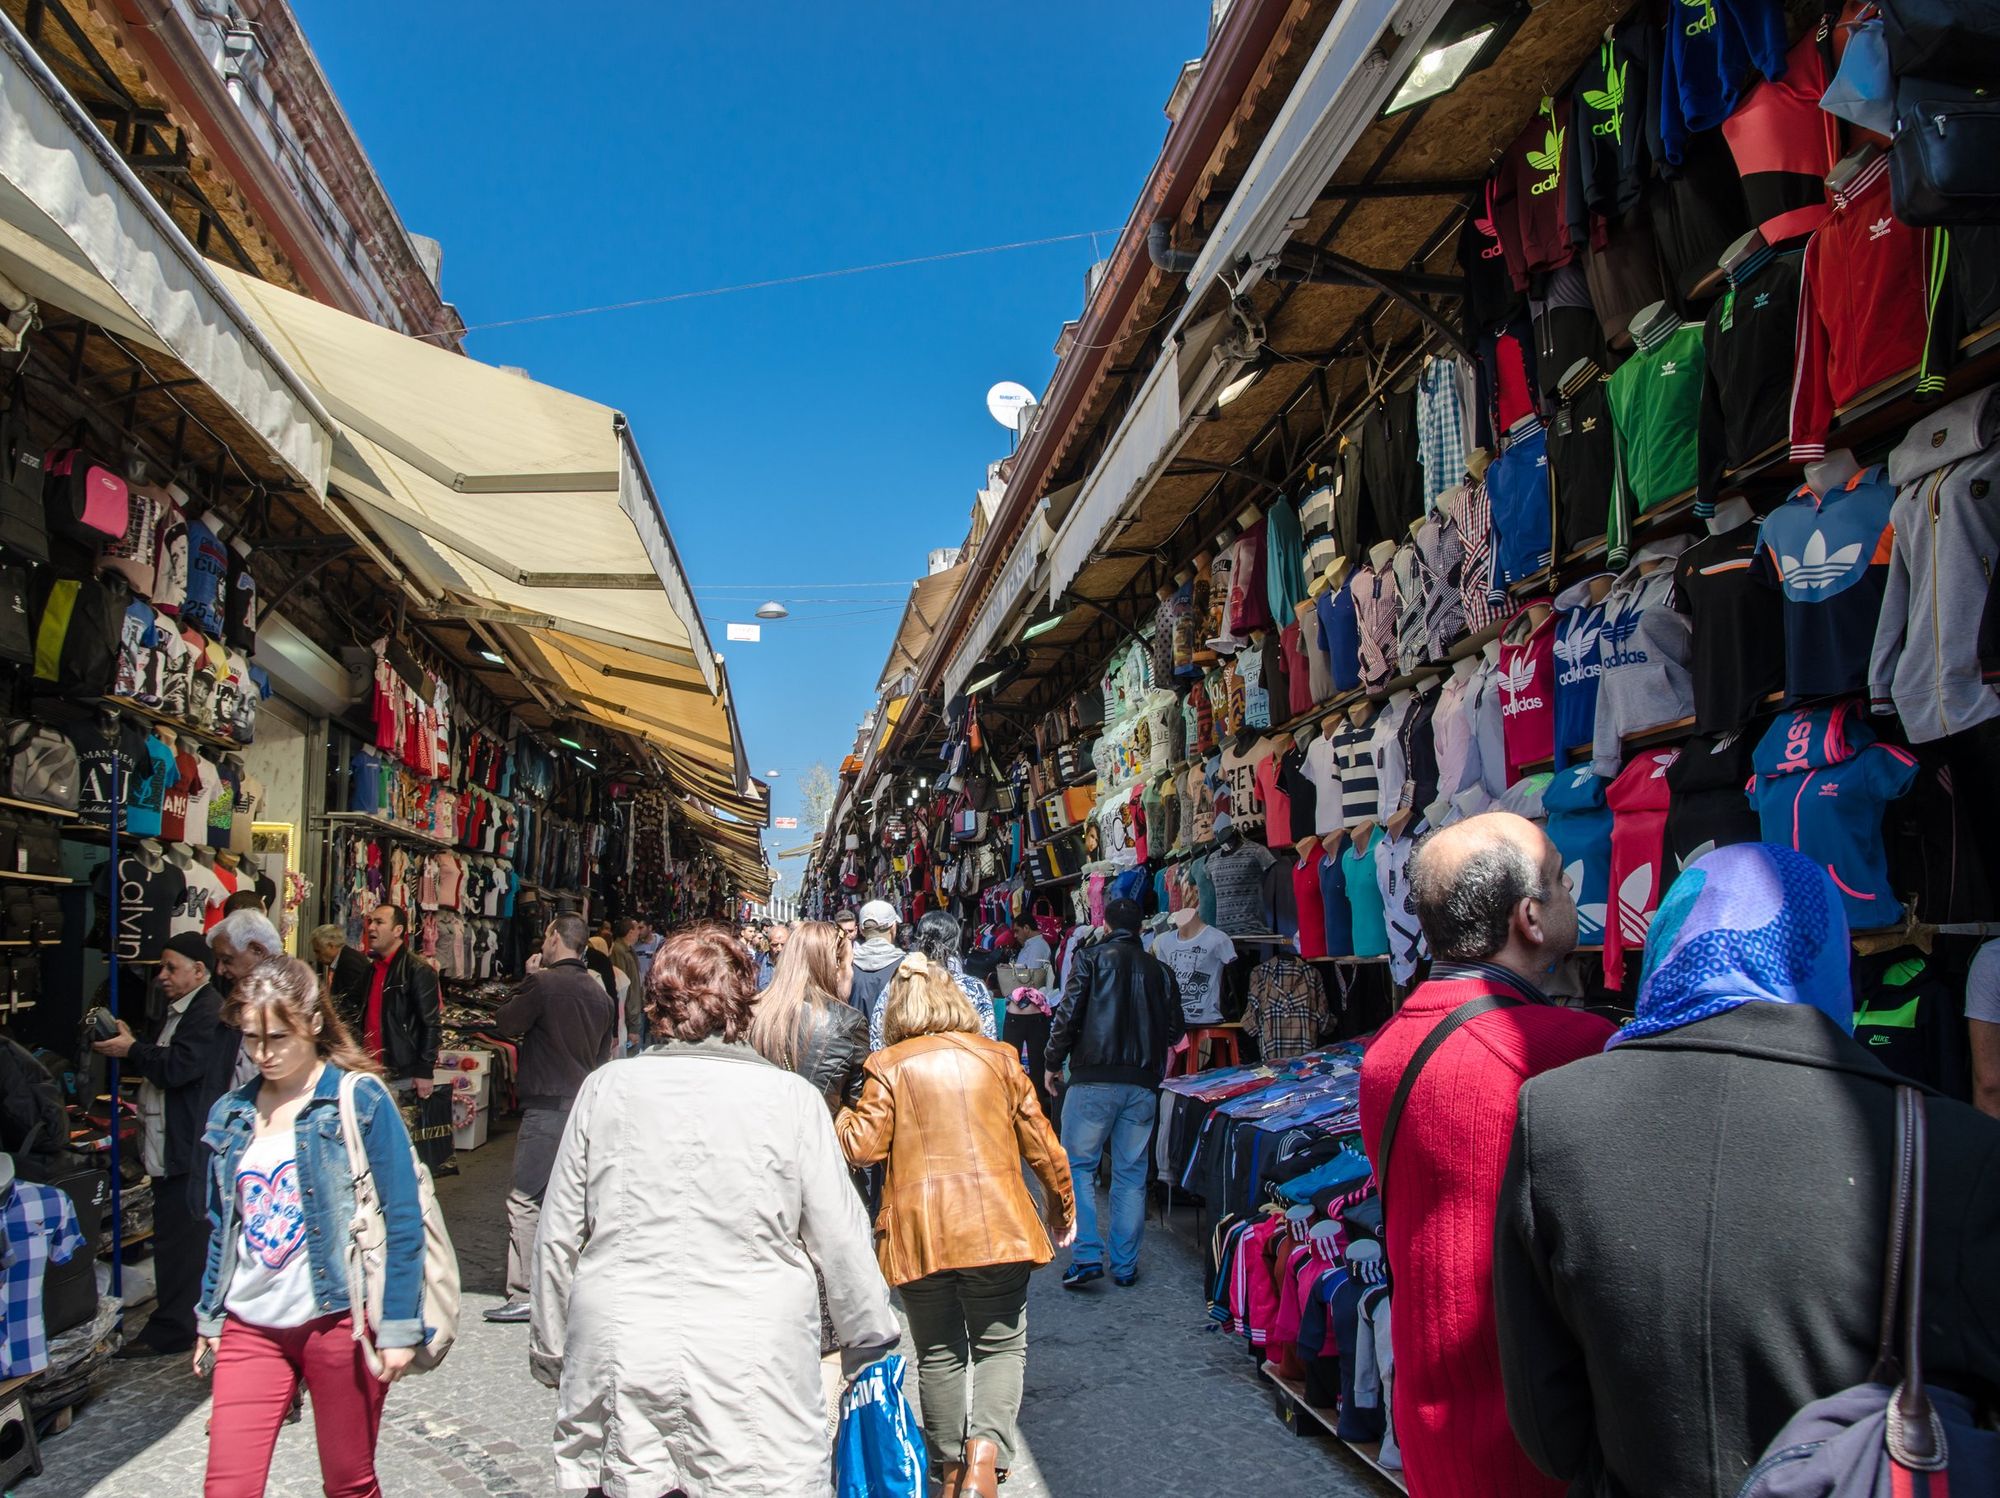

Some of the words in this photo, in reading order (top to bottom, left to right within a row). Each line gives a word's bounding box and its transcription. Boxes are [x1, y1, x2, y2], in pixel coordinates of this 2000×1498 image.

[1601, 649, 1648, 670] adidas
[1558, 662, 1601, 686] adidas
[1502, 696, 1543, 718] adidas
[116, 858, 154, 960] Calvin
[1872, 1033, 1891, 1043] NIKE
